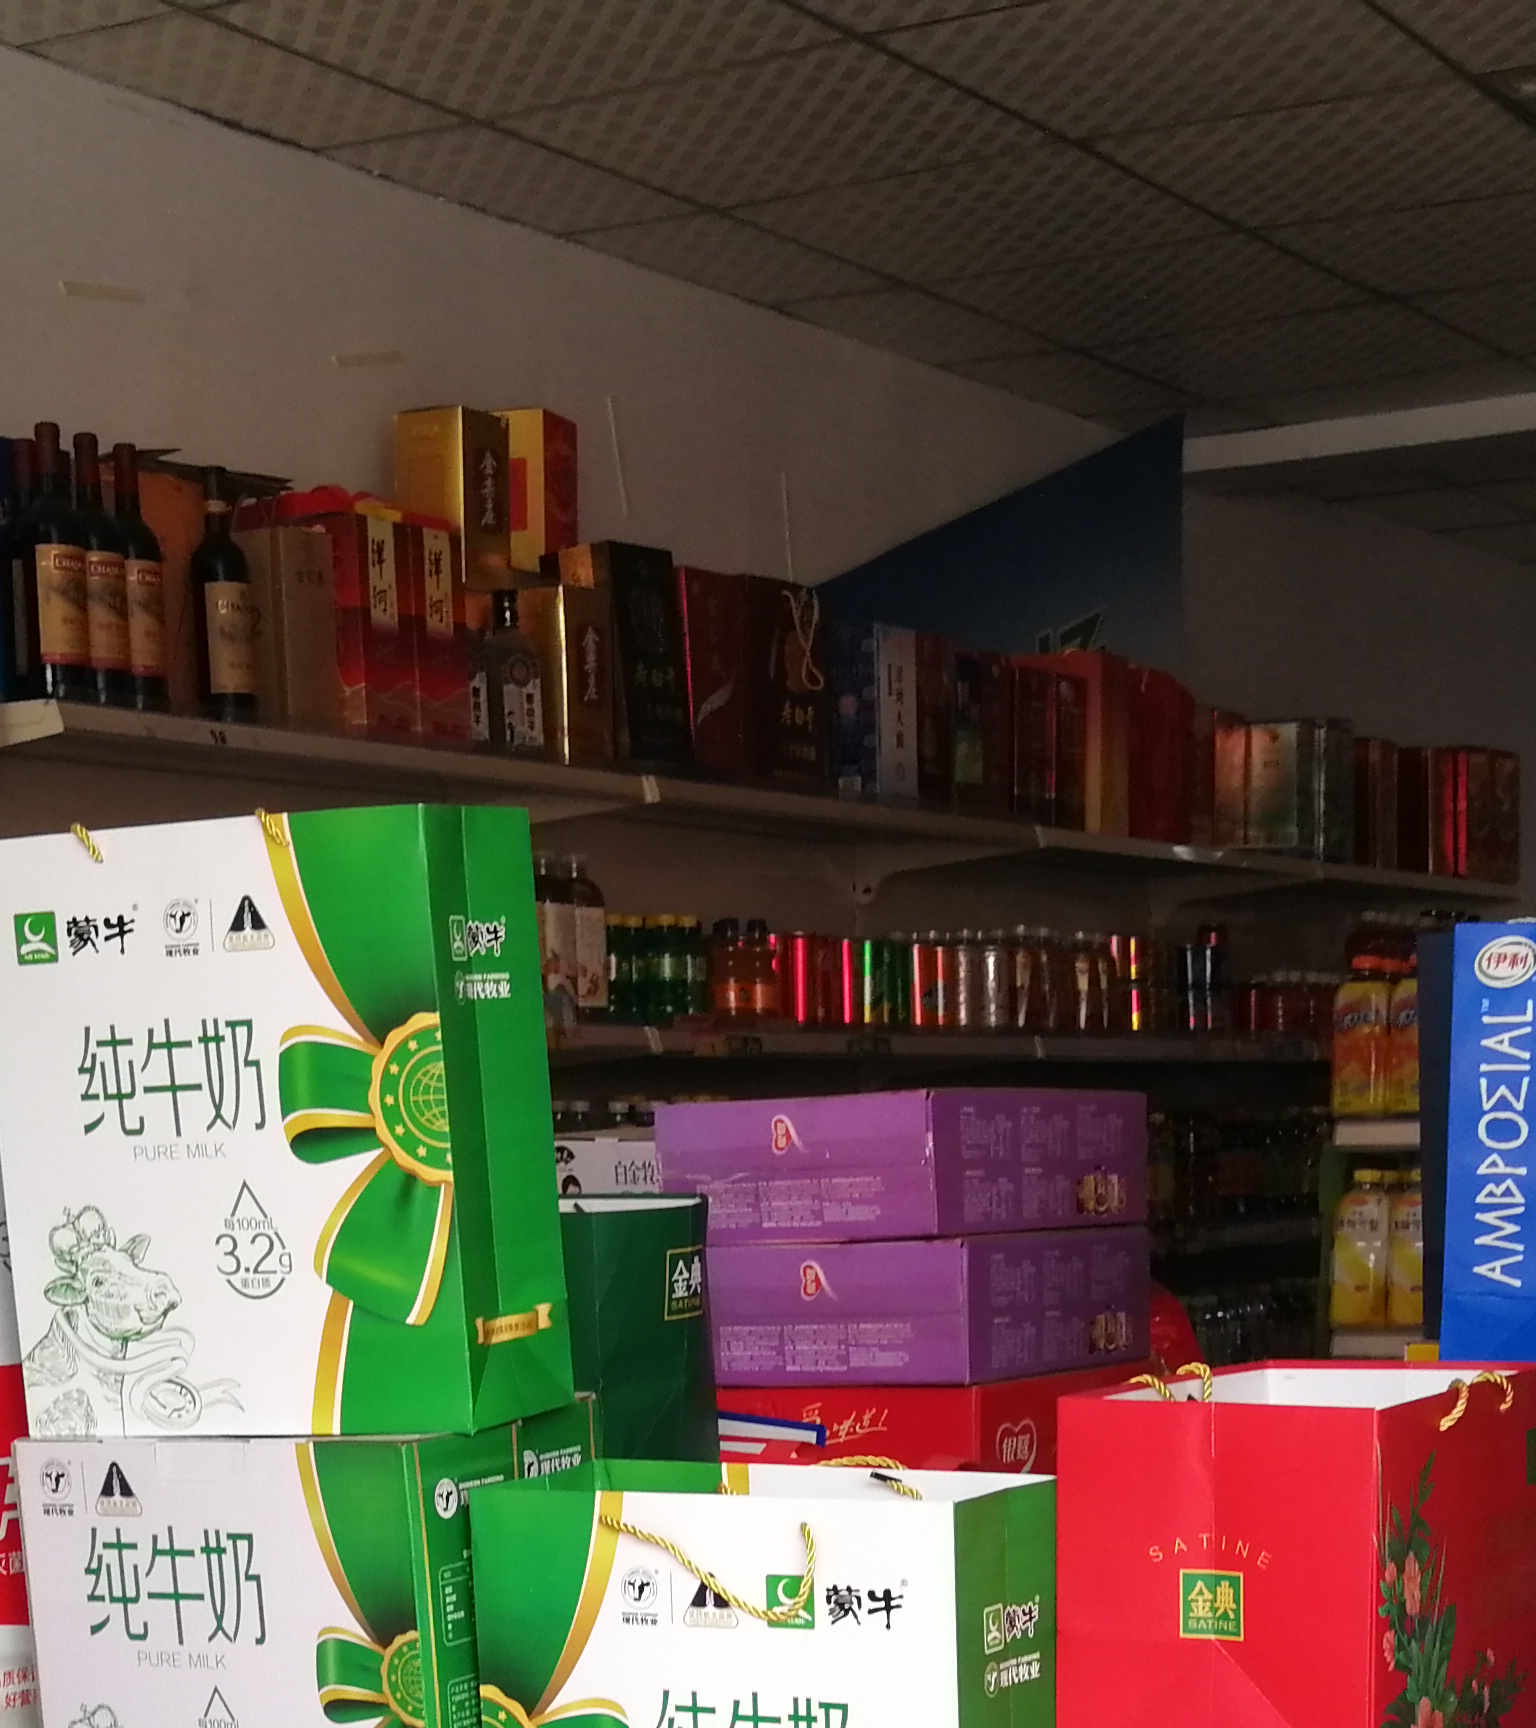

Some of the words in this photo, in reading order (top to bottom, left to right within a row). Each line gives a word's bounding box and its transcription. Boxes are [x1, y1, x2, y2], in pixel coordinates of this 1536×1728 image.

[65, 913, 137, 959] 蒙牛
[1484, 950, 1530, 973] 伊利
[77, 1017, 267, 1138] 纯牛奶
[132, 1144, 182, 1163] PURE
[186, 1142, 227, 1161] MILK
[214, 1232, 294, 1277] 3.2g
[671, 1255, 702, 1300] 金典
[1148, 1532, 1273, 1570] SATINE
[84, 1525, 267, 1646] 纯牛奶
[825, 1582, 905, 1631] 蒙牛
[1187, 1579, 1237, 1618] 金典
[1187, 1617, 1237, 1632] SATINE
[136, 1650, 183, 1669] PURE
[187, 1650, 227, 1670] MILK
